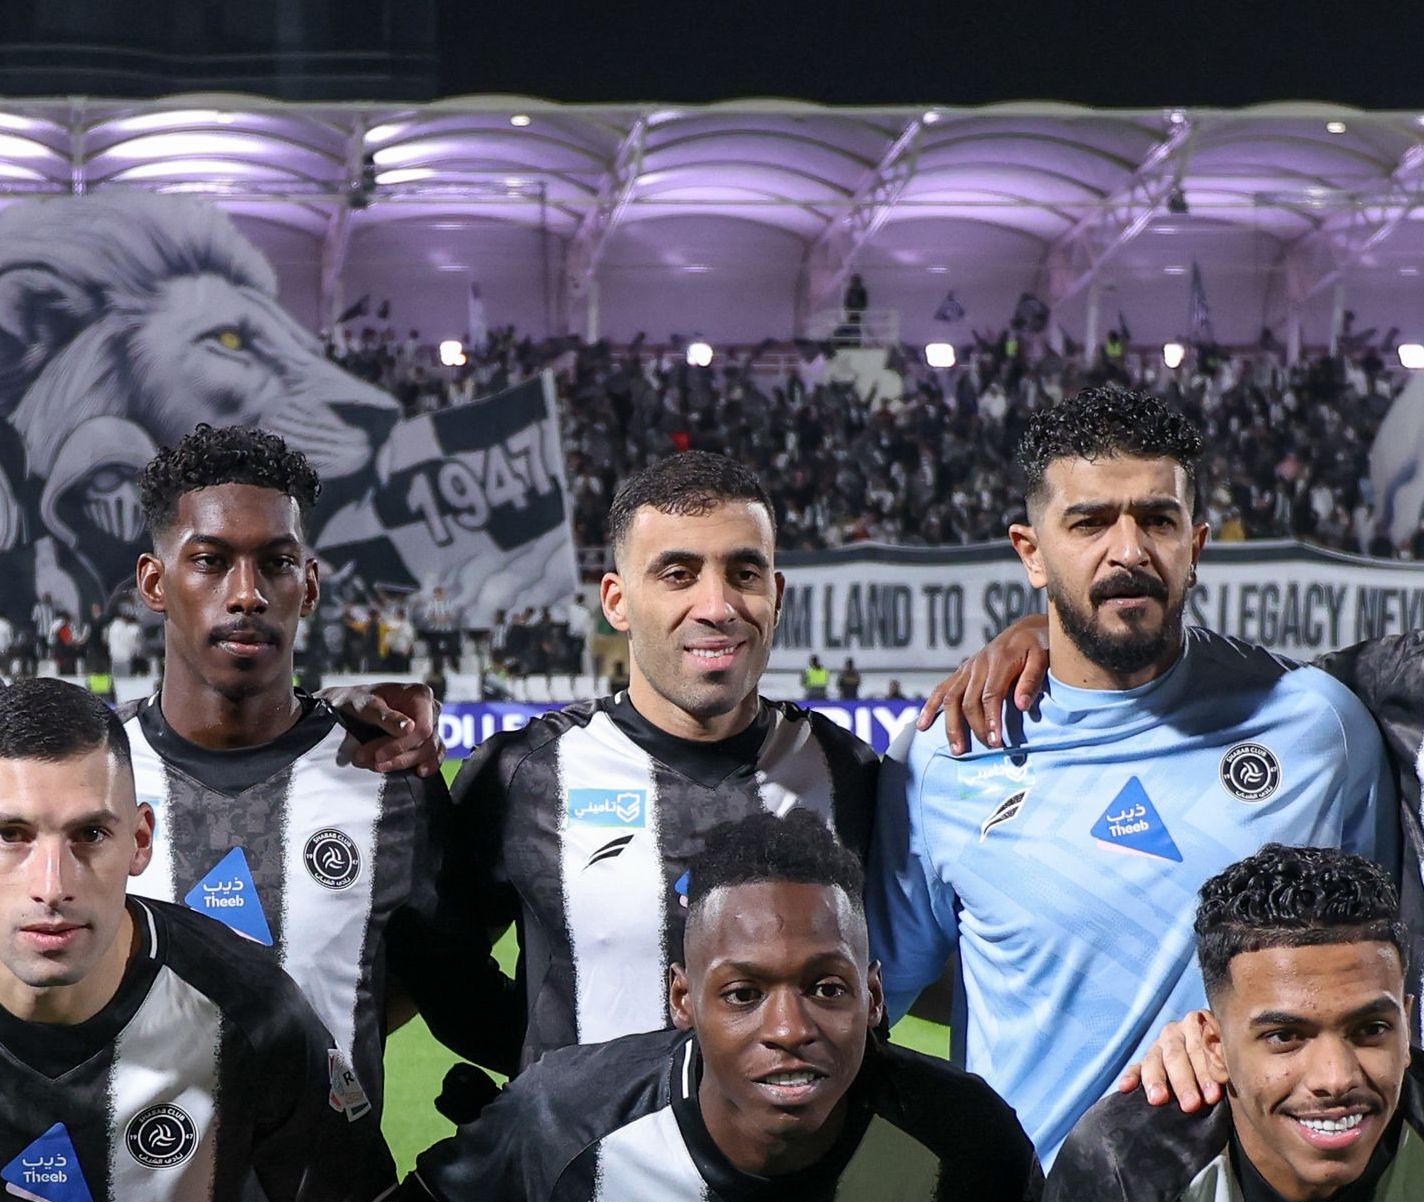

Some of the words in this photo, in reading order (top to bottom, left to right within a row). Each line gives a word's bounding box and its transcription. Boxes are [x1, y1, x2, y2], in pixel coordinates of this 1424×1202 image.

[406, 421, 552, 547] 1947
[824, 582, 912, 648] LAND
[923, 583, 964, 648] TO
[1218, 580, 1348, 648] LEGACY
[1106, 804, 1146, 824] ذيب
[1109, 819, 1149, 837] Theeb
[203, 877, 244, 895] ذيب
[203, 894, 244, 908] Theeb
[139, 1108, 166, 1122] SHABAB
[166, 1108, 185, 1121] CLUB
[22, 1153, 67, 1170] ذيب
[23, 1170, 67, 1183] Theeb
